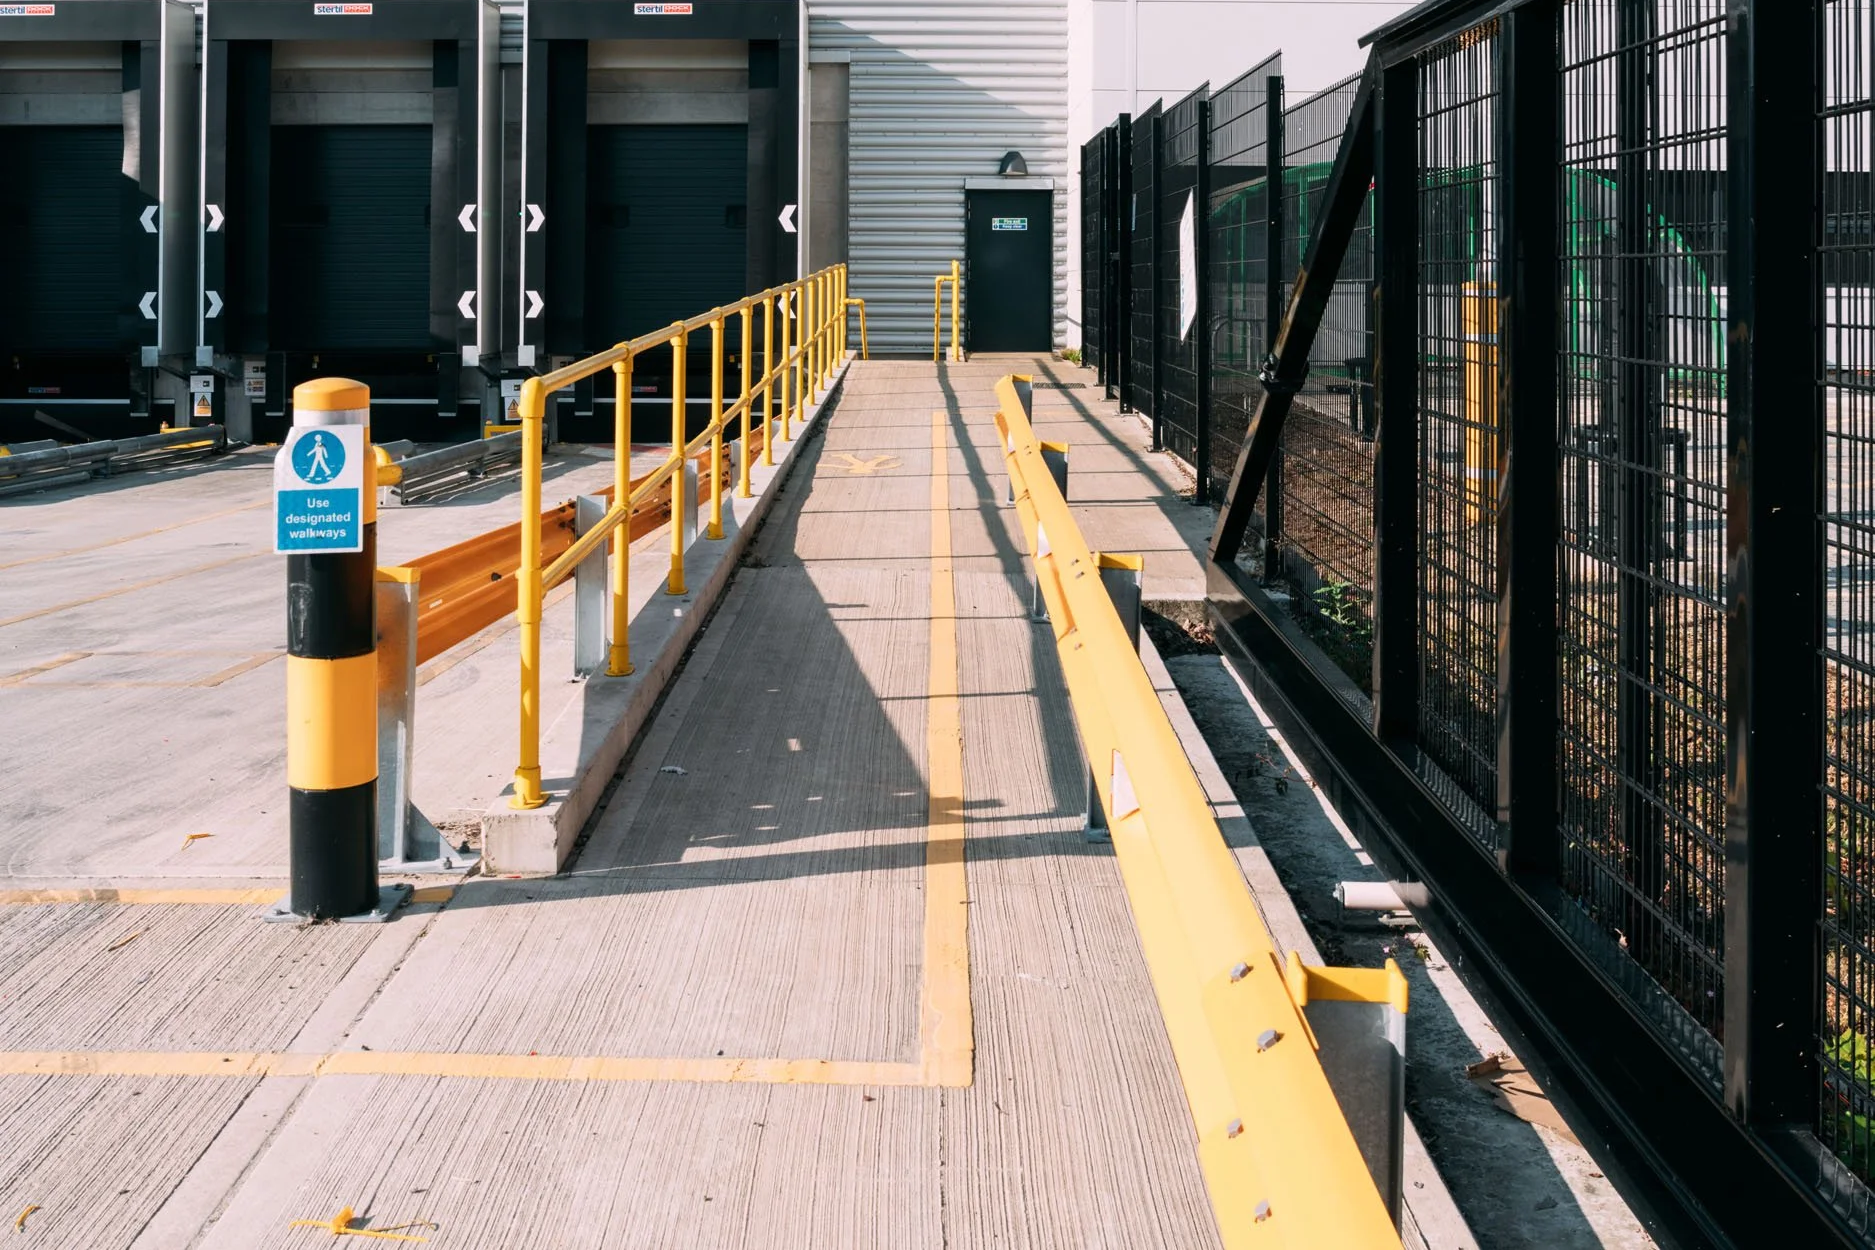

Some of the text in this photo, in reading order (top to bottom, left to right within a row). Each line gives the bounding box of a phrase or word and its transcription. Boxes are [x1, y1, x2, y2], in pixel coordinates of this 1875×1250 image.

[0, 6, 25, 14] stertil
[317, 5, 343, 13] stertil
[637, 5, 663, 13] stertil
[307, 498, 330, 509] Use
[285, 512, 351, 525] designated
[289, 527, 347, 540] walkways
